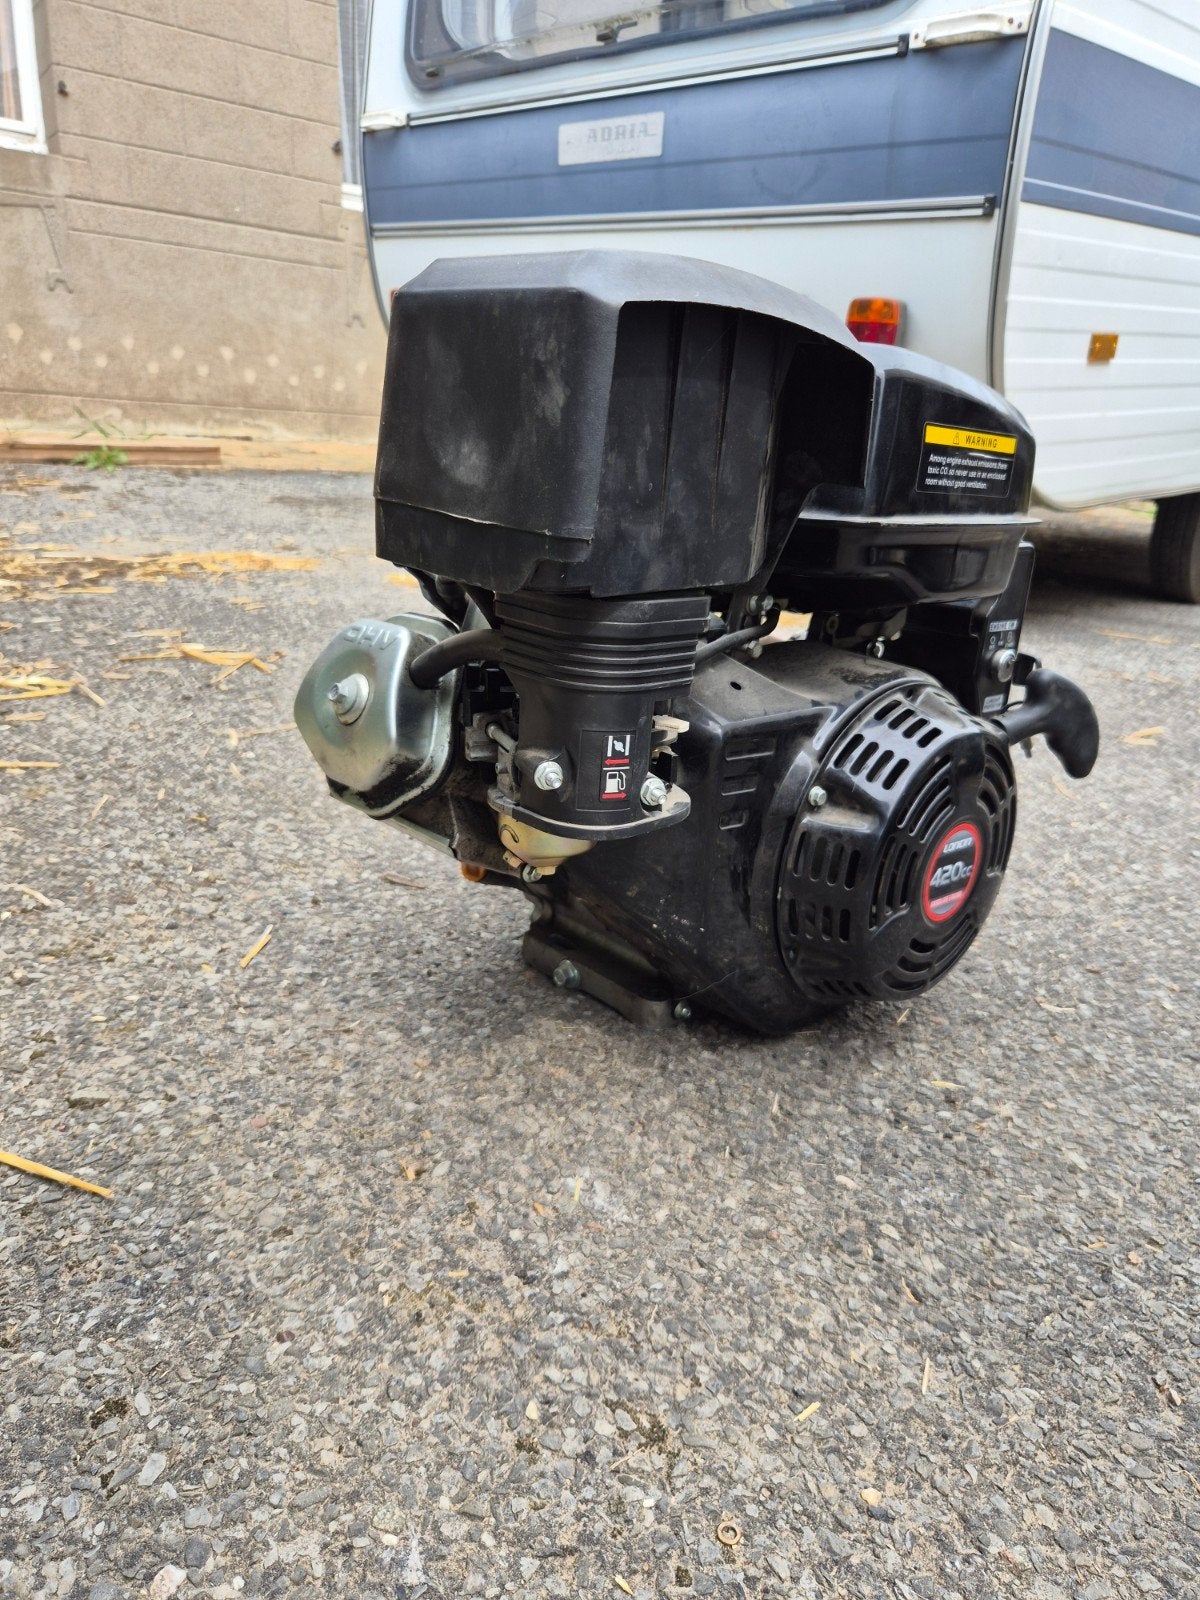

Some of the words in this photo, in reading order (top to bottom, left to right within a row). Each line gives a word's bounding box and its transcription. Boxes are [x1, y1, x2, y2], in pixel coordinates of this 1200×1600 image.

[588, 121, 657, 143] ADRIA
[965, 435, 998, 448] WARNING
[928, 454, 946, 465] Among
[946, 457, 961, 466] engine
[962, 458, 978, 467] exhaust
[978, 460, 998, 469] emissions
[927, 466, 939, 474] toxic
[955, 480, 966, 488] good
[930, 861, 974, 887] 420cc
